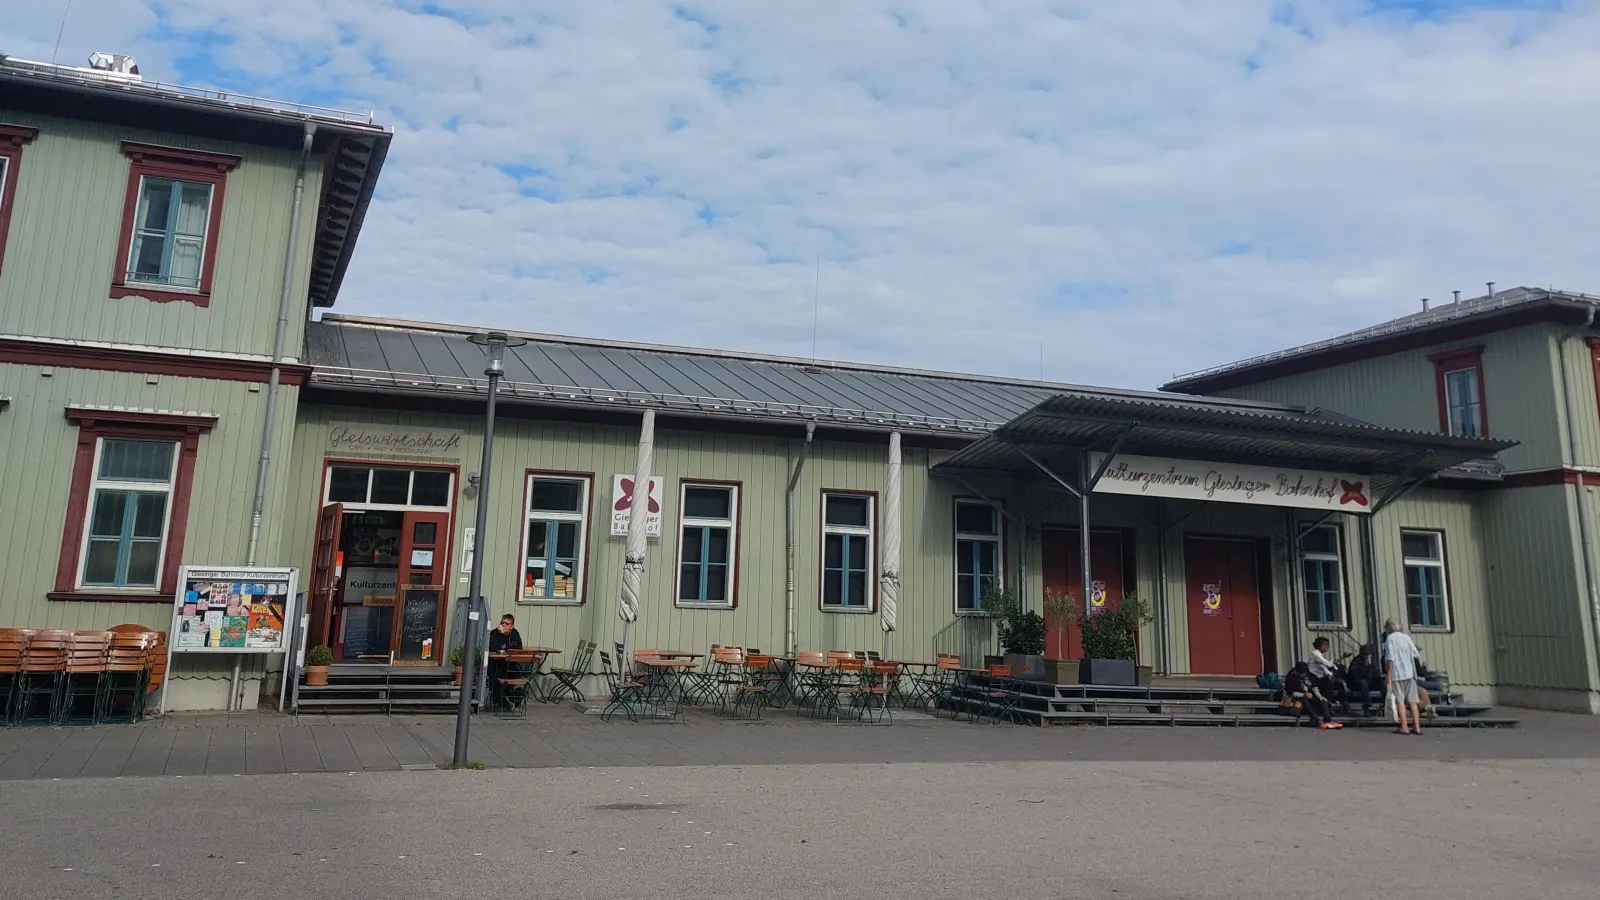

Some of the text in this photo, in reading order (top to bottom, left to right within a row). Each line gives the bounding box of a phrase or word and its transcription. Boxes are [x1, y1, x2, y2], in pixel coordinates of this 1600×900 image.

[329, 427, 461, 451] Gleiswirtschaft
[396, 447, 436, 455] RESTAURANT
[1097, 459, 1338, 504] ulturzentrum Giesinger Bahnhof
[613, 522, 659, 531] Baof
